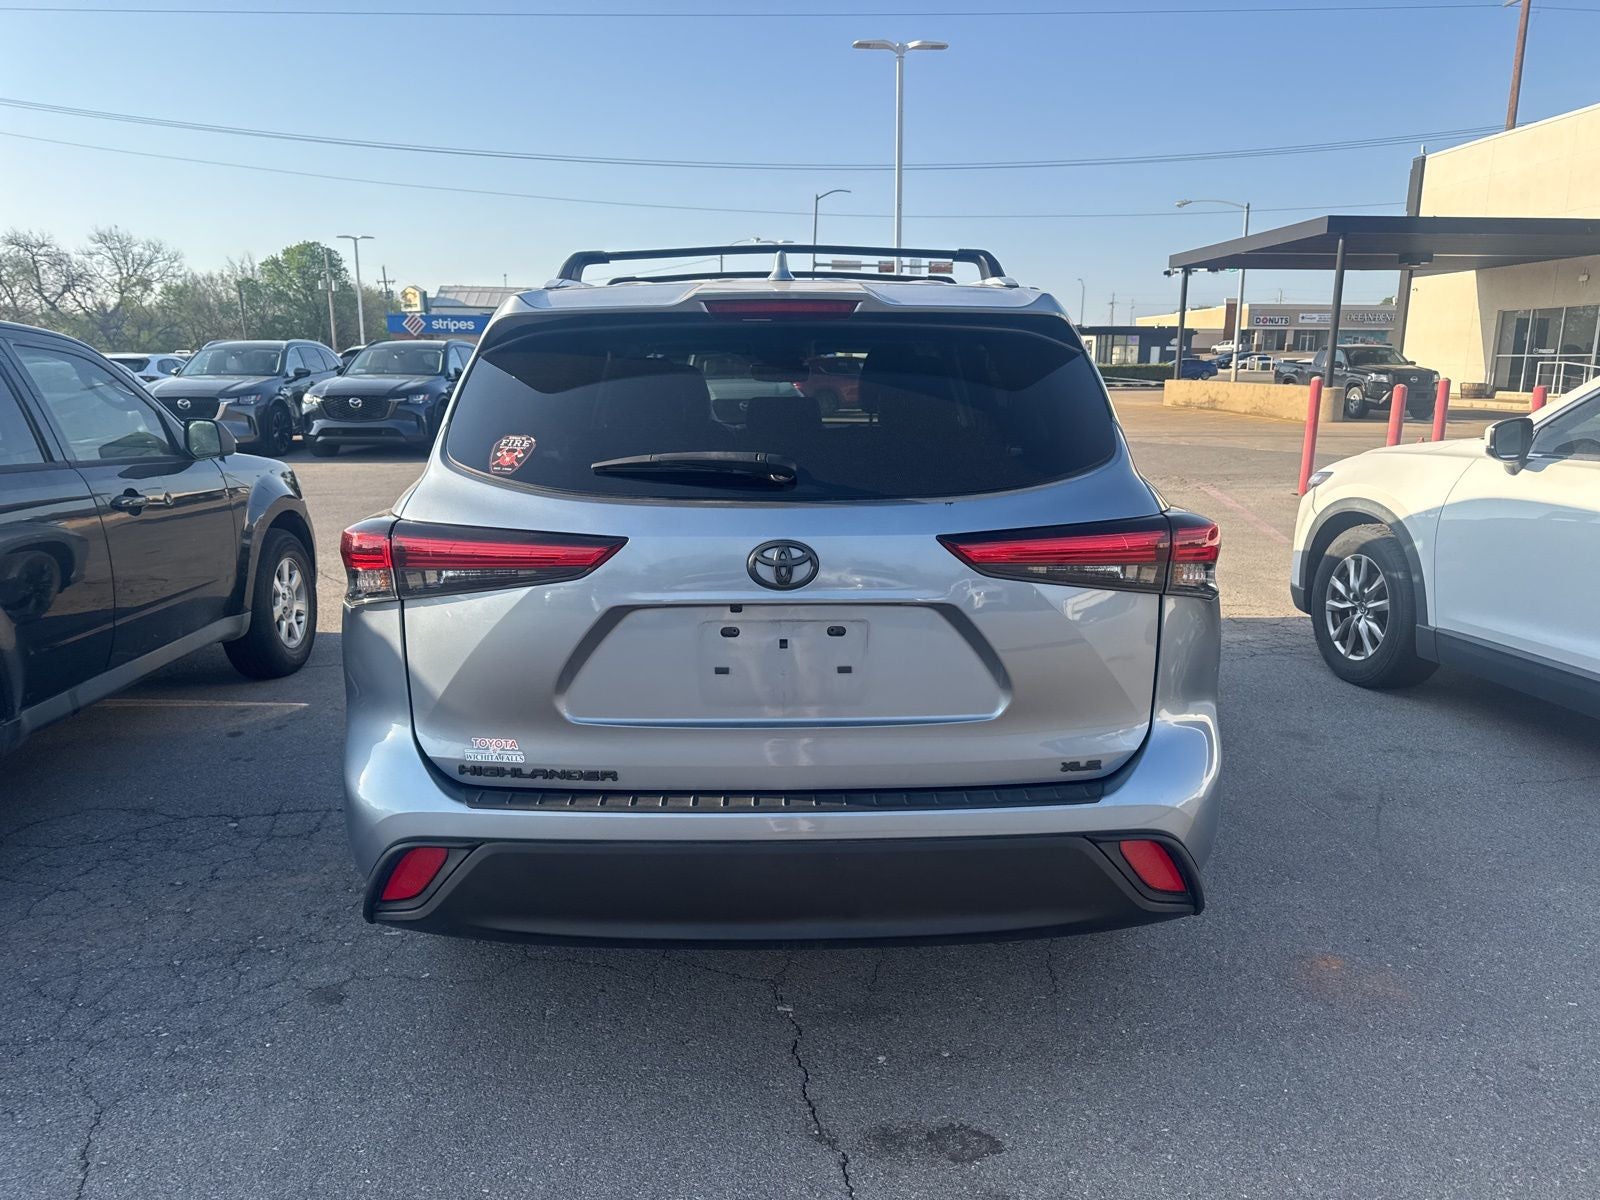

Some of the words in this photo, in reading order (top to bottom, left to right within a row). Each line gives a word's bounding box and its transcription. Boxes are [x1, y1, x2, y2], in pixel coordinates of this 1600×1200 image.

[432, 318, 475, 332] stripes
[500, 439, 532, 448] FIRE
[472, 738, 518, 750] TOYOTA
[465, 753, 499, 762] WICHITA
[500, 755, 525, 763] FALLS
[1060, 760, 1102, 772] XLE
[458, 764, 619, 782] HIGHLANDER
